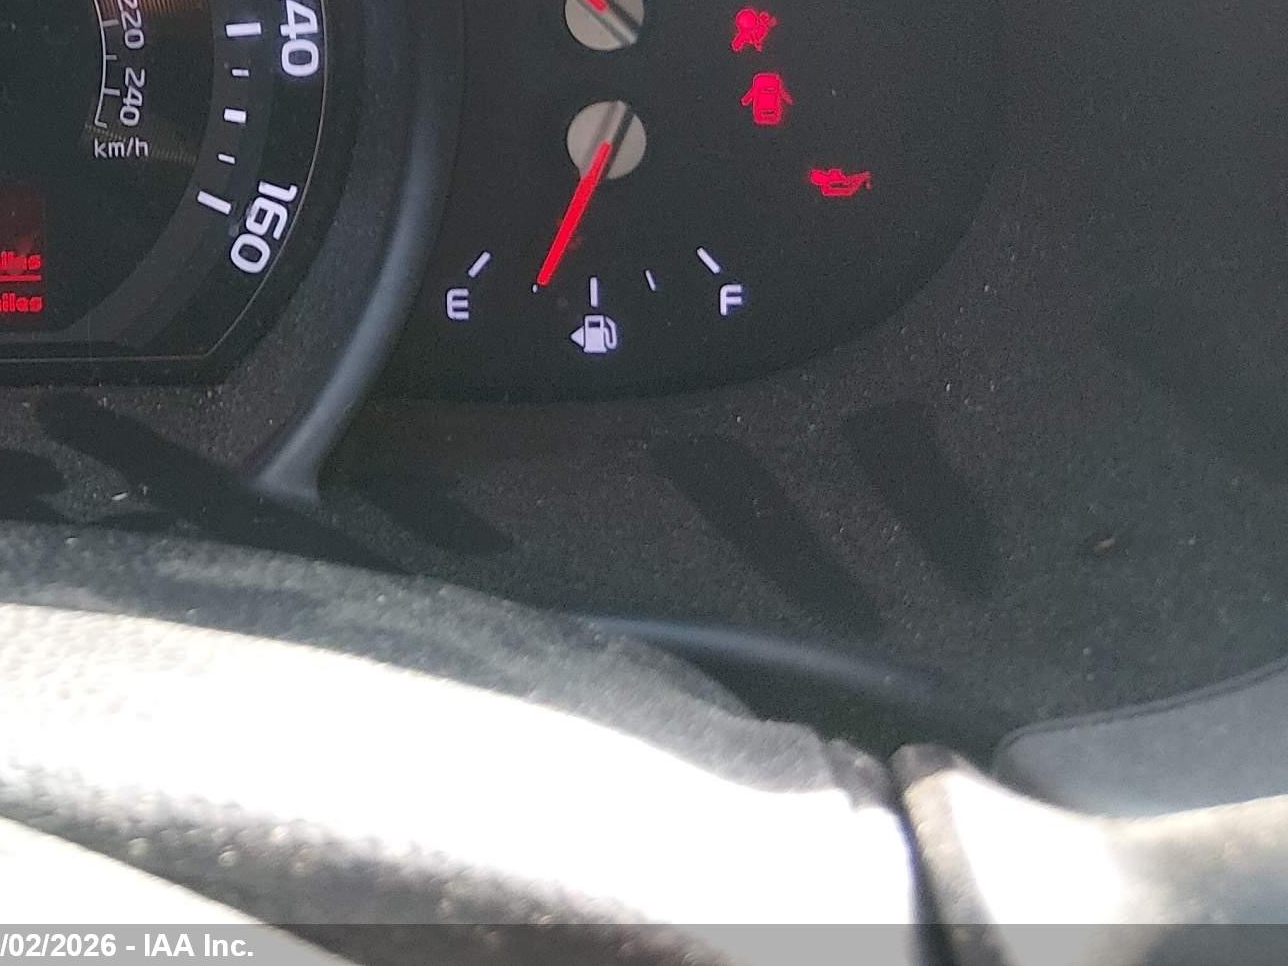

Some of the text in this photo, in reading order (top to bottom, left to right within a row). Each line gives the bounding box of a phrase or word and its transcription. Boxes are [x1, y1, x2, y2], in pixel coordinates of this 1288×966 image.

[117, 67, 146, 127] 240
[93, 136, 149, 160] km/h
[230, 182, 300, 275] 160
[446, 287, 470, 320] E
[719, 283, 744, 316] F
